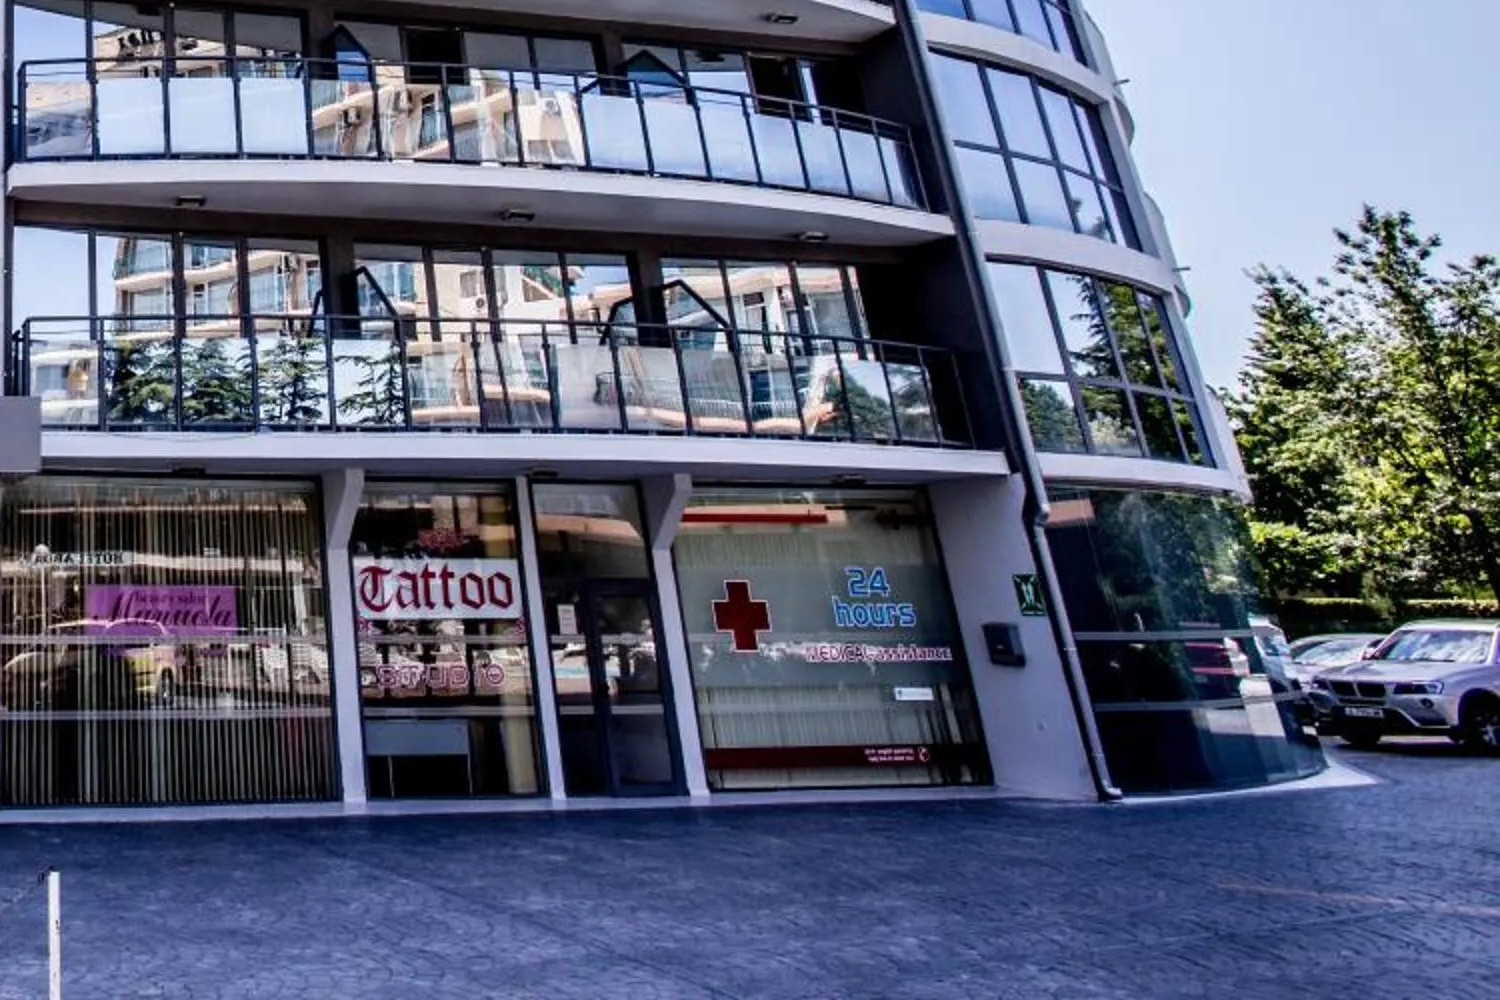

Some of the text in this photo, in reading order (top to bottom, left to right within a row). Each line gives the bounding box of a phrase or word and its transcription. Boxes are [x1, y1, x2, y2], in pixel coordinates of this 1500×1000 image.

[360, 563, 513, 612] Tattoo
[844, 566, 891, 598] 24
[831, 595, 917, 628] hours
